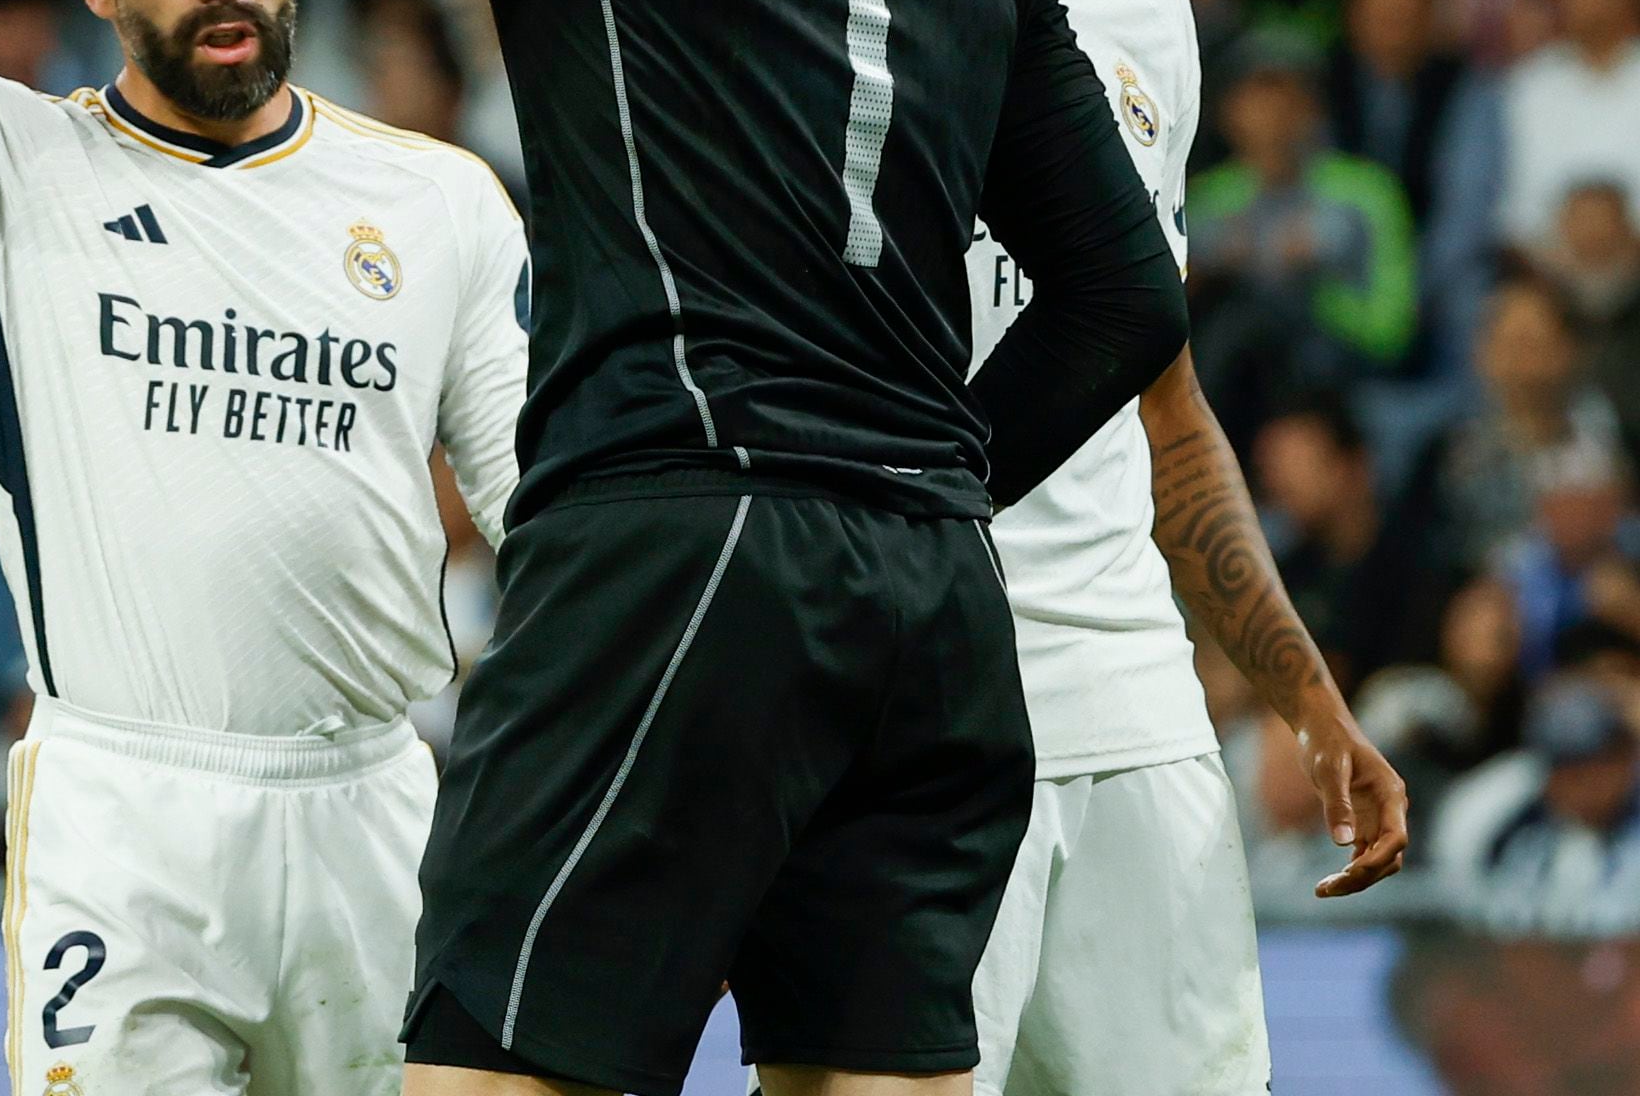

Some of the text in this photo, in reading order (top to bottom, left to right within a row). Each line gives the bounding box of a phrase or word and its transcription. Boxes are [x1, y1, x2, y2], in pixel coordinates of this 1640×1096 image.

[97, 292, 397, 392] Emirates
[144, 380, 357, 452] FLY BETTER
[42, 930, 107, 1049] 2
